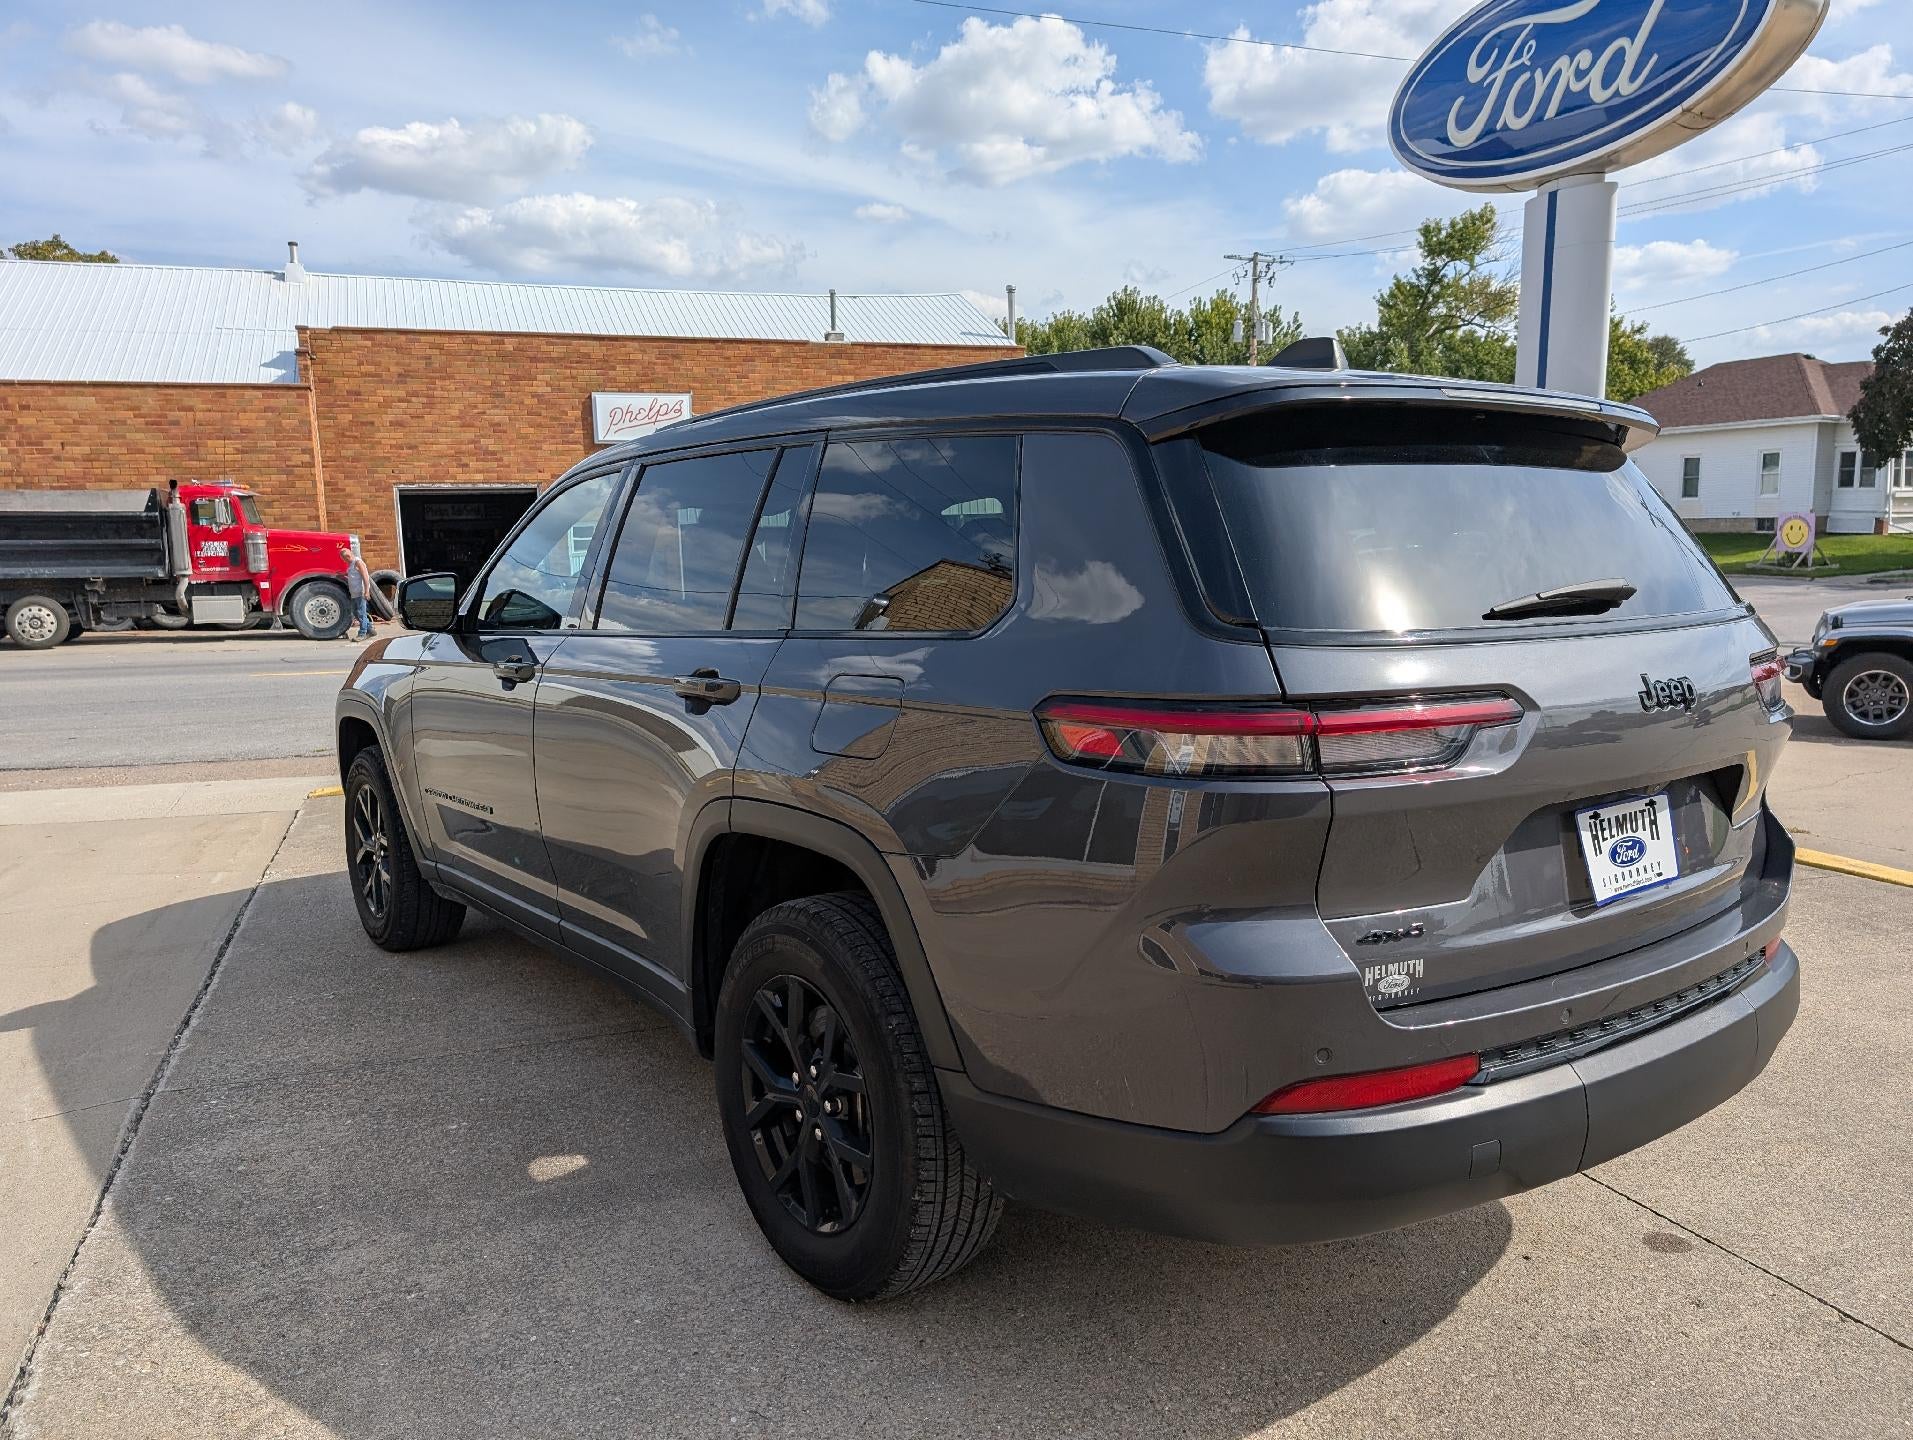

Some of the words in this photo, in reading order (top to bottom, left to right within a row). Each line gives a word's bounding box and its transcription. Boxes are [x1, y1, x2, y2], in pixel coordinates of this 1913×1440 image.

[1446, 0, 1665, 148] Ford
[603, 397, 684, 440] Phelps
[1638, 673, 1697, 713] Jeep
[1589, 806, 1660, 857] HELMUTH
[1615, 841, 1640, 864] Ford
[1365, 959, 1423, 987] HELMUTH
